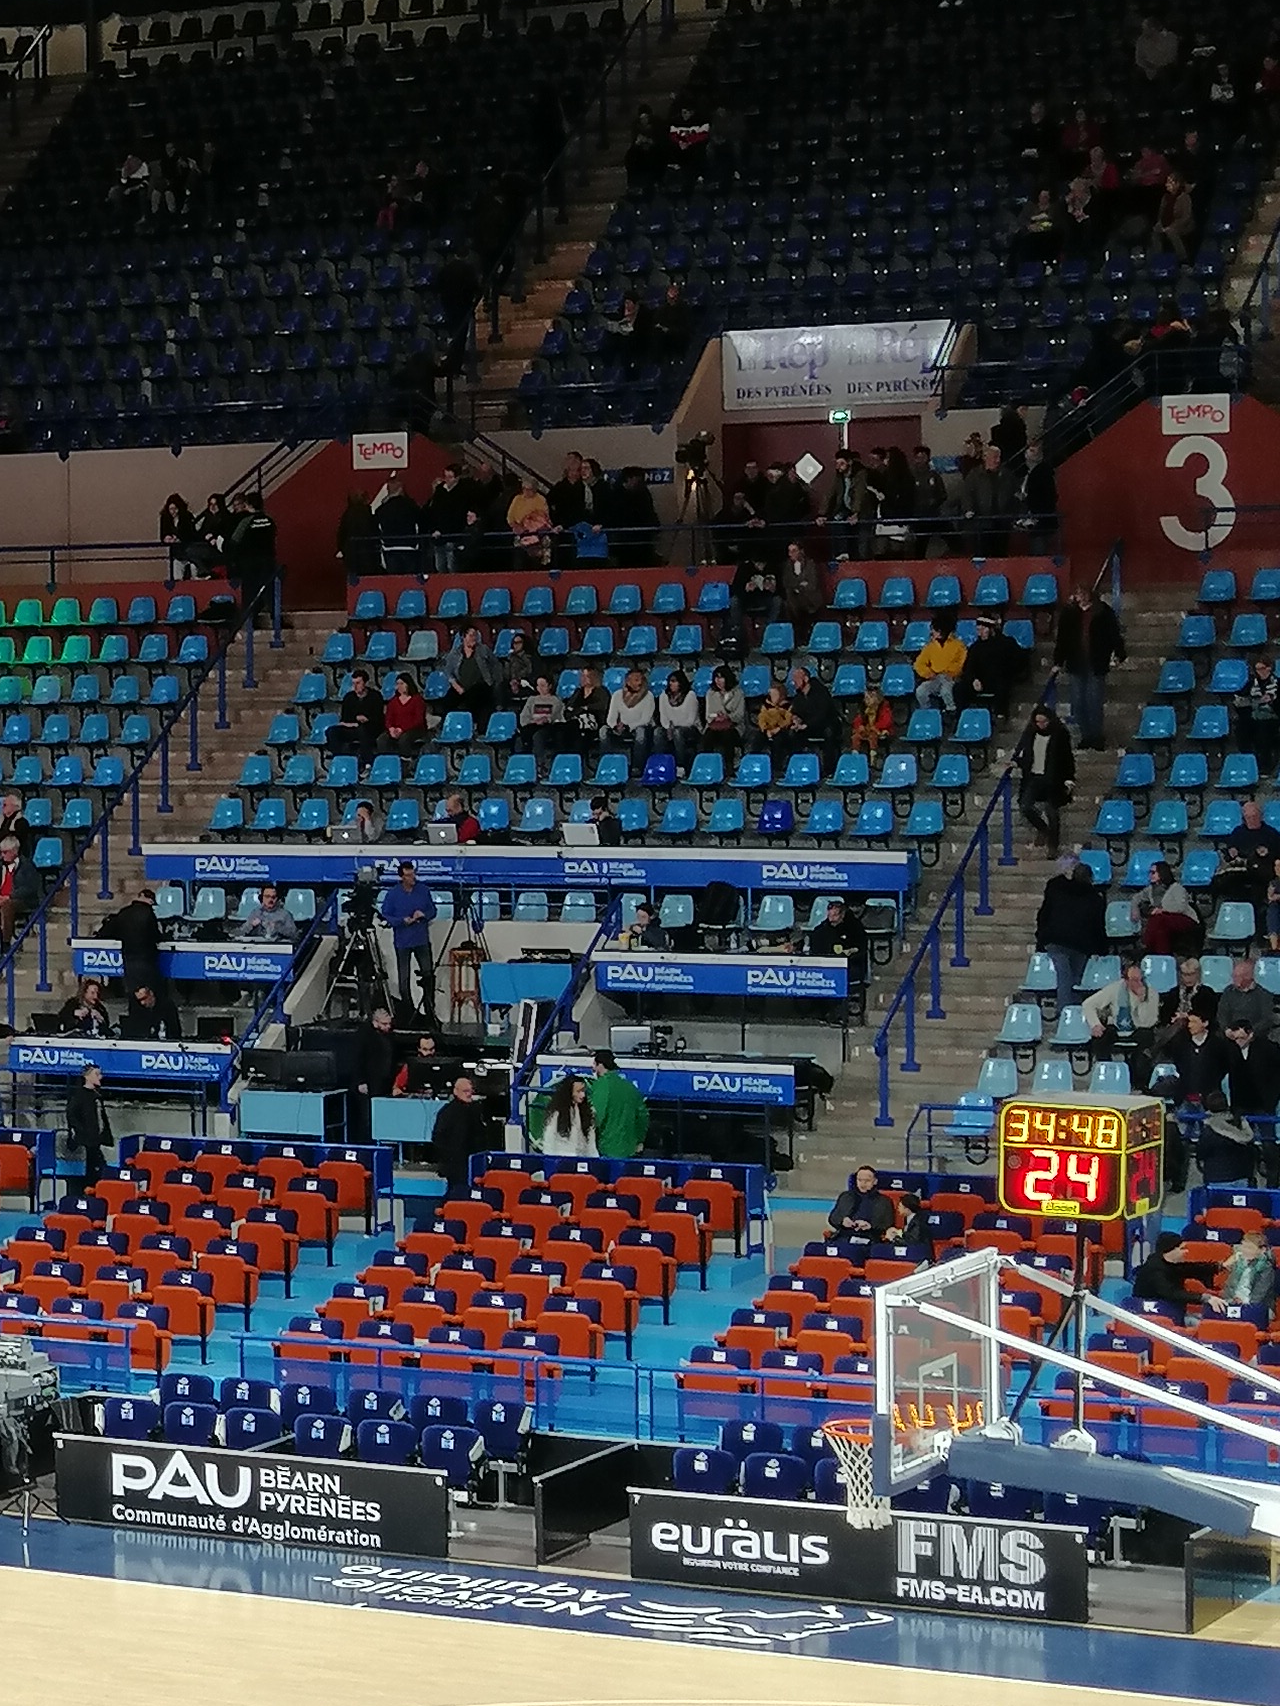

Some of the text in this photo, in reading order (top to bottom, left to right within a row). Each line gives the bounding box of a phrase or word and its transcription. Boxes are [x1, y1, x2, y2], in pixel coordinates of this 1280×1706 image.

[736, 382, 832, 400] DES PYRÉNÉES
[847, 381, 873, 394] DES
[1167, 404, 1225, 425] TEMPO
[357, 442, 404, 460] TEMPO
[1159, 435, 1237, 552] 3
[195, 856, 236, 874] PAU
[762, 862, 810, 881] PAU
[83, 950, 123, 967] PAU
[204, 954, 246, 971] PAU
[607, 964, 655, 982] PAU
[747, 967, 795, 986] PAU
[18, 1048, 60, 1066] PAU
[141, 1052, 185, 1071] PAU
[693, 1073, 742, 1093] PAU
[1007, 1108, 1119, 1148] 34:48
[1024, 1149, 1100, 1202] 24
[111, 1449, 252, 1508] PAU
[259, 1464, 341, 1494] BÉARN
[259, 1490, 382, 1522] PYRÉNÉES
[111, 1503, 382, 1548] Communauté d'Agglomération
[897, 1518, 1046, 1586] FMS
[340, 1564, 632, 1603] Aquitaine
[896, 1577, 1046, 1612] FMS-EA.COM
